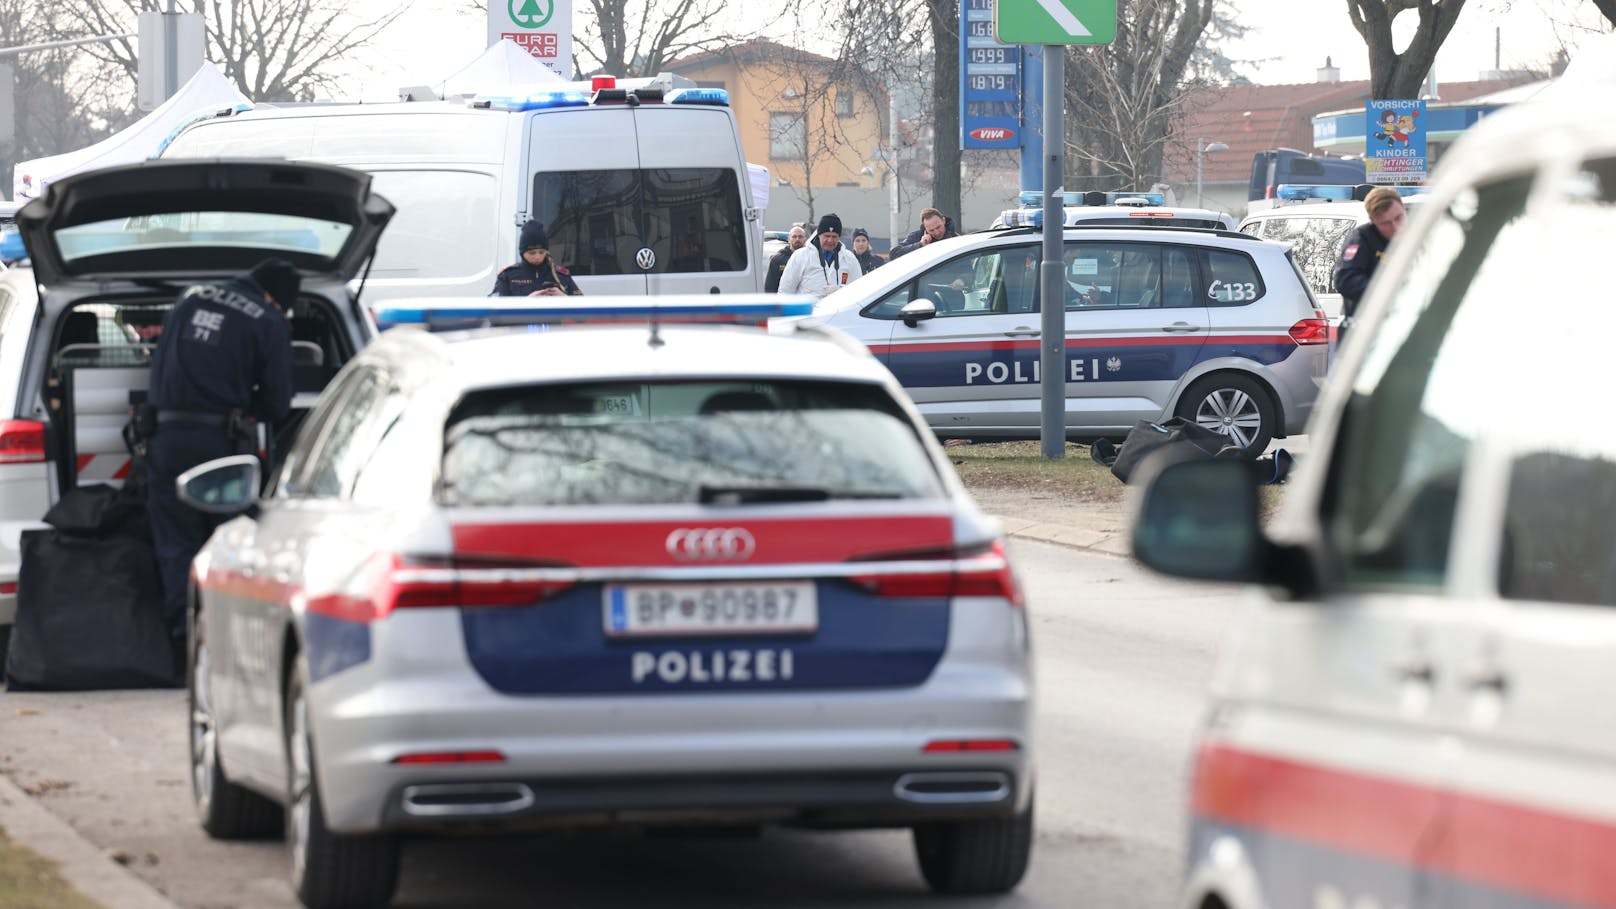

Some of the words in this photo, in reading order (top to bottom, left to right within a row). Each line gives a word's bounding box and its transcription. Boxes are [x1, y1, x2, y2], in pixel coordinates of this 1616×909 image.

[1371, 101, 1421, 109] VORSICHT
[980, 130, 1004, 139] VIVA
[1376, 149, 1416, 157] KINDER
[1223, 282, 1257, 301] 133
[184, 285, 265, 319] POLIZEI
[192, 309, 225, 331] BE
[965, 358, 1100, 385] POLIEI
[631, 650, 794, 683] POLIZEI
